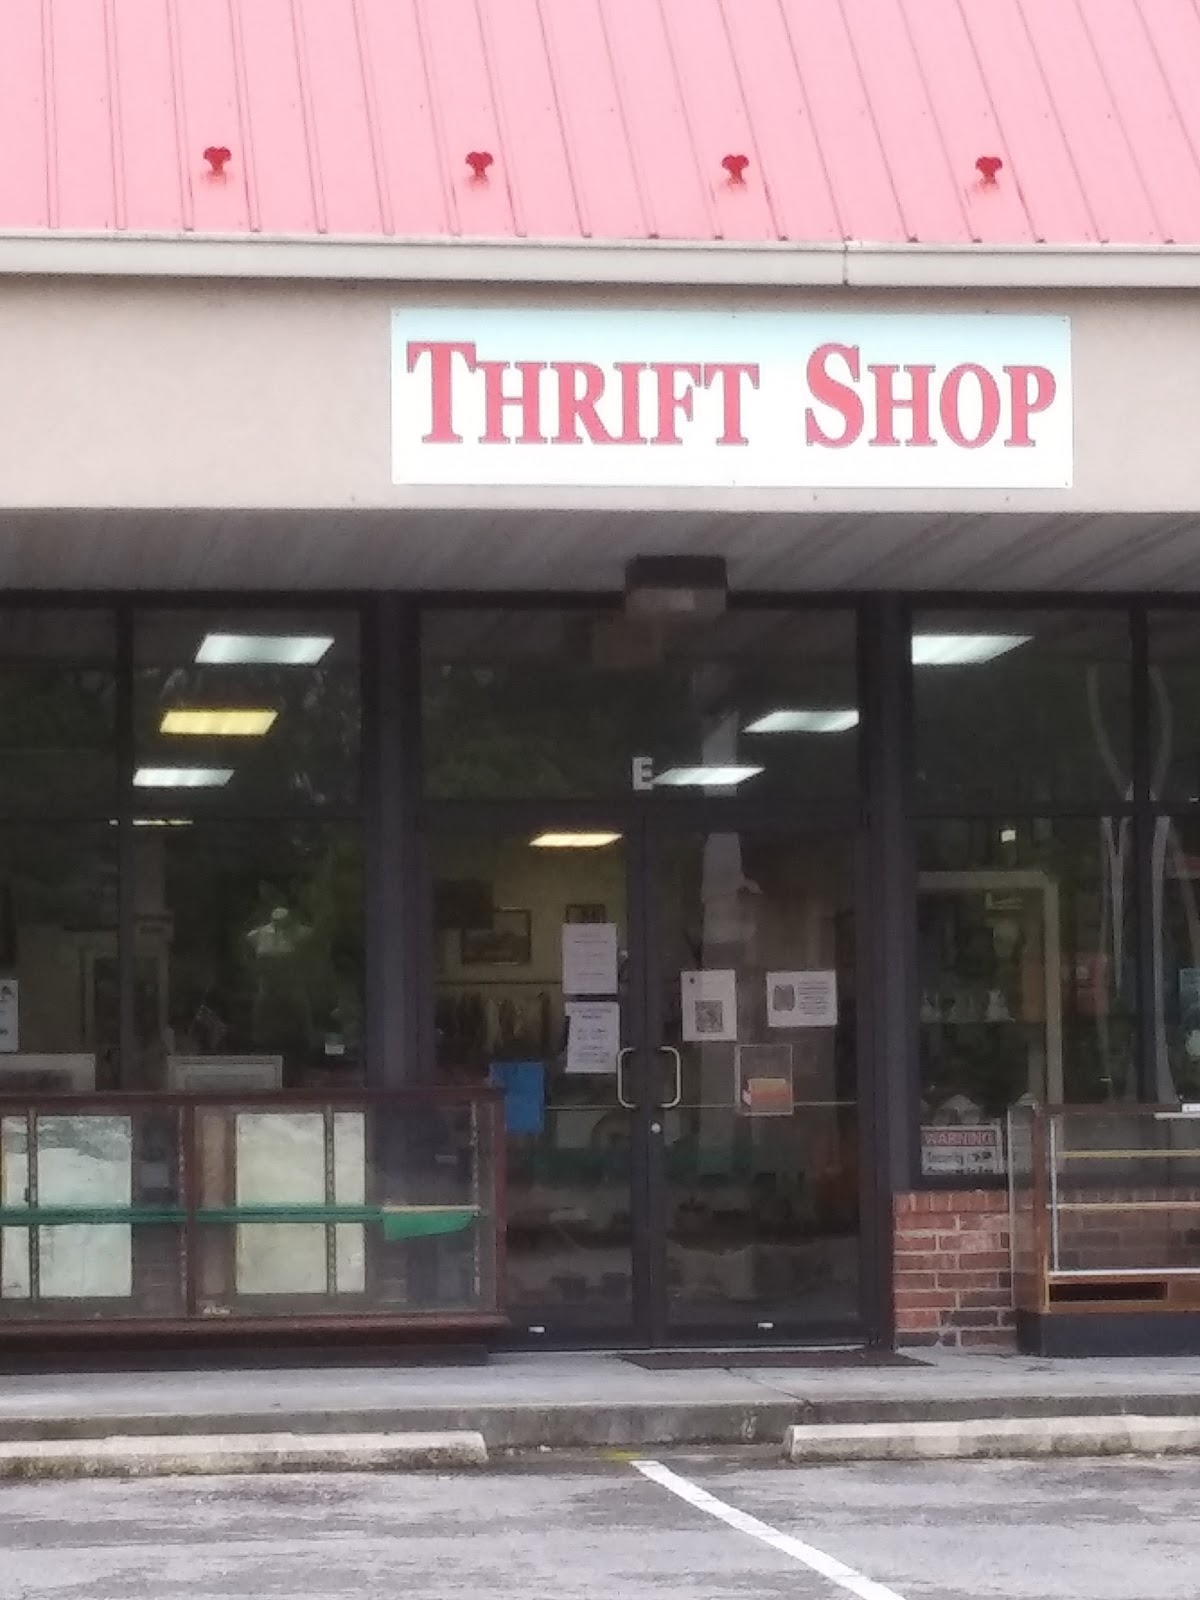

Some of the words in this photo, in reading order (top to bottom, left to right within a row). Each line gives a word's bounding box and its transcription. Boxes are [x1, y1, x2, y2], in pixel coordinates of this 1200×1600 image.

[407, 341, 759, 446] THRIFT
[806, 343, 1056, 448] SHOP
[632, 757, 654, 790] E
[923, 1131, 994, 1146] WARNING
